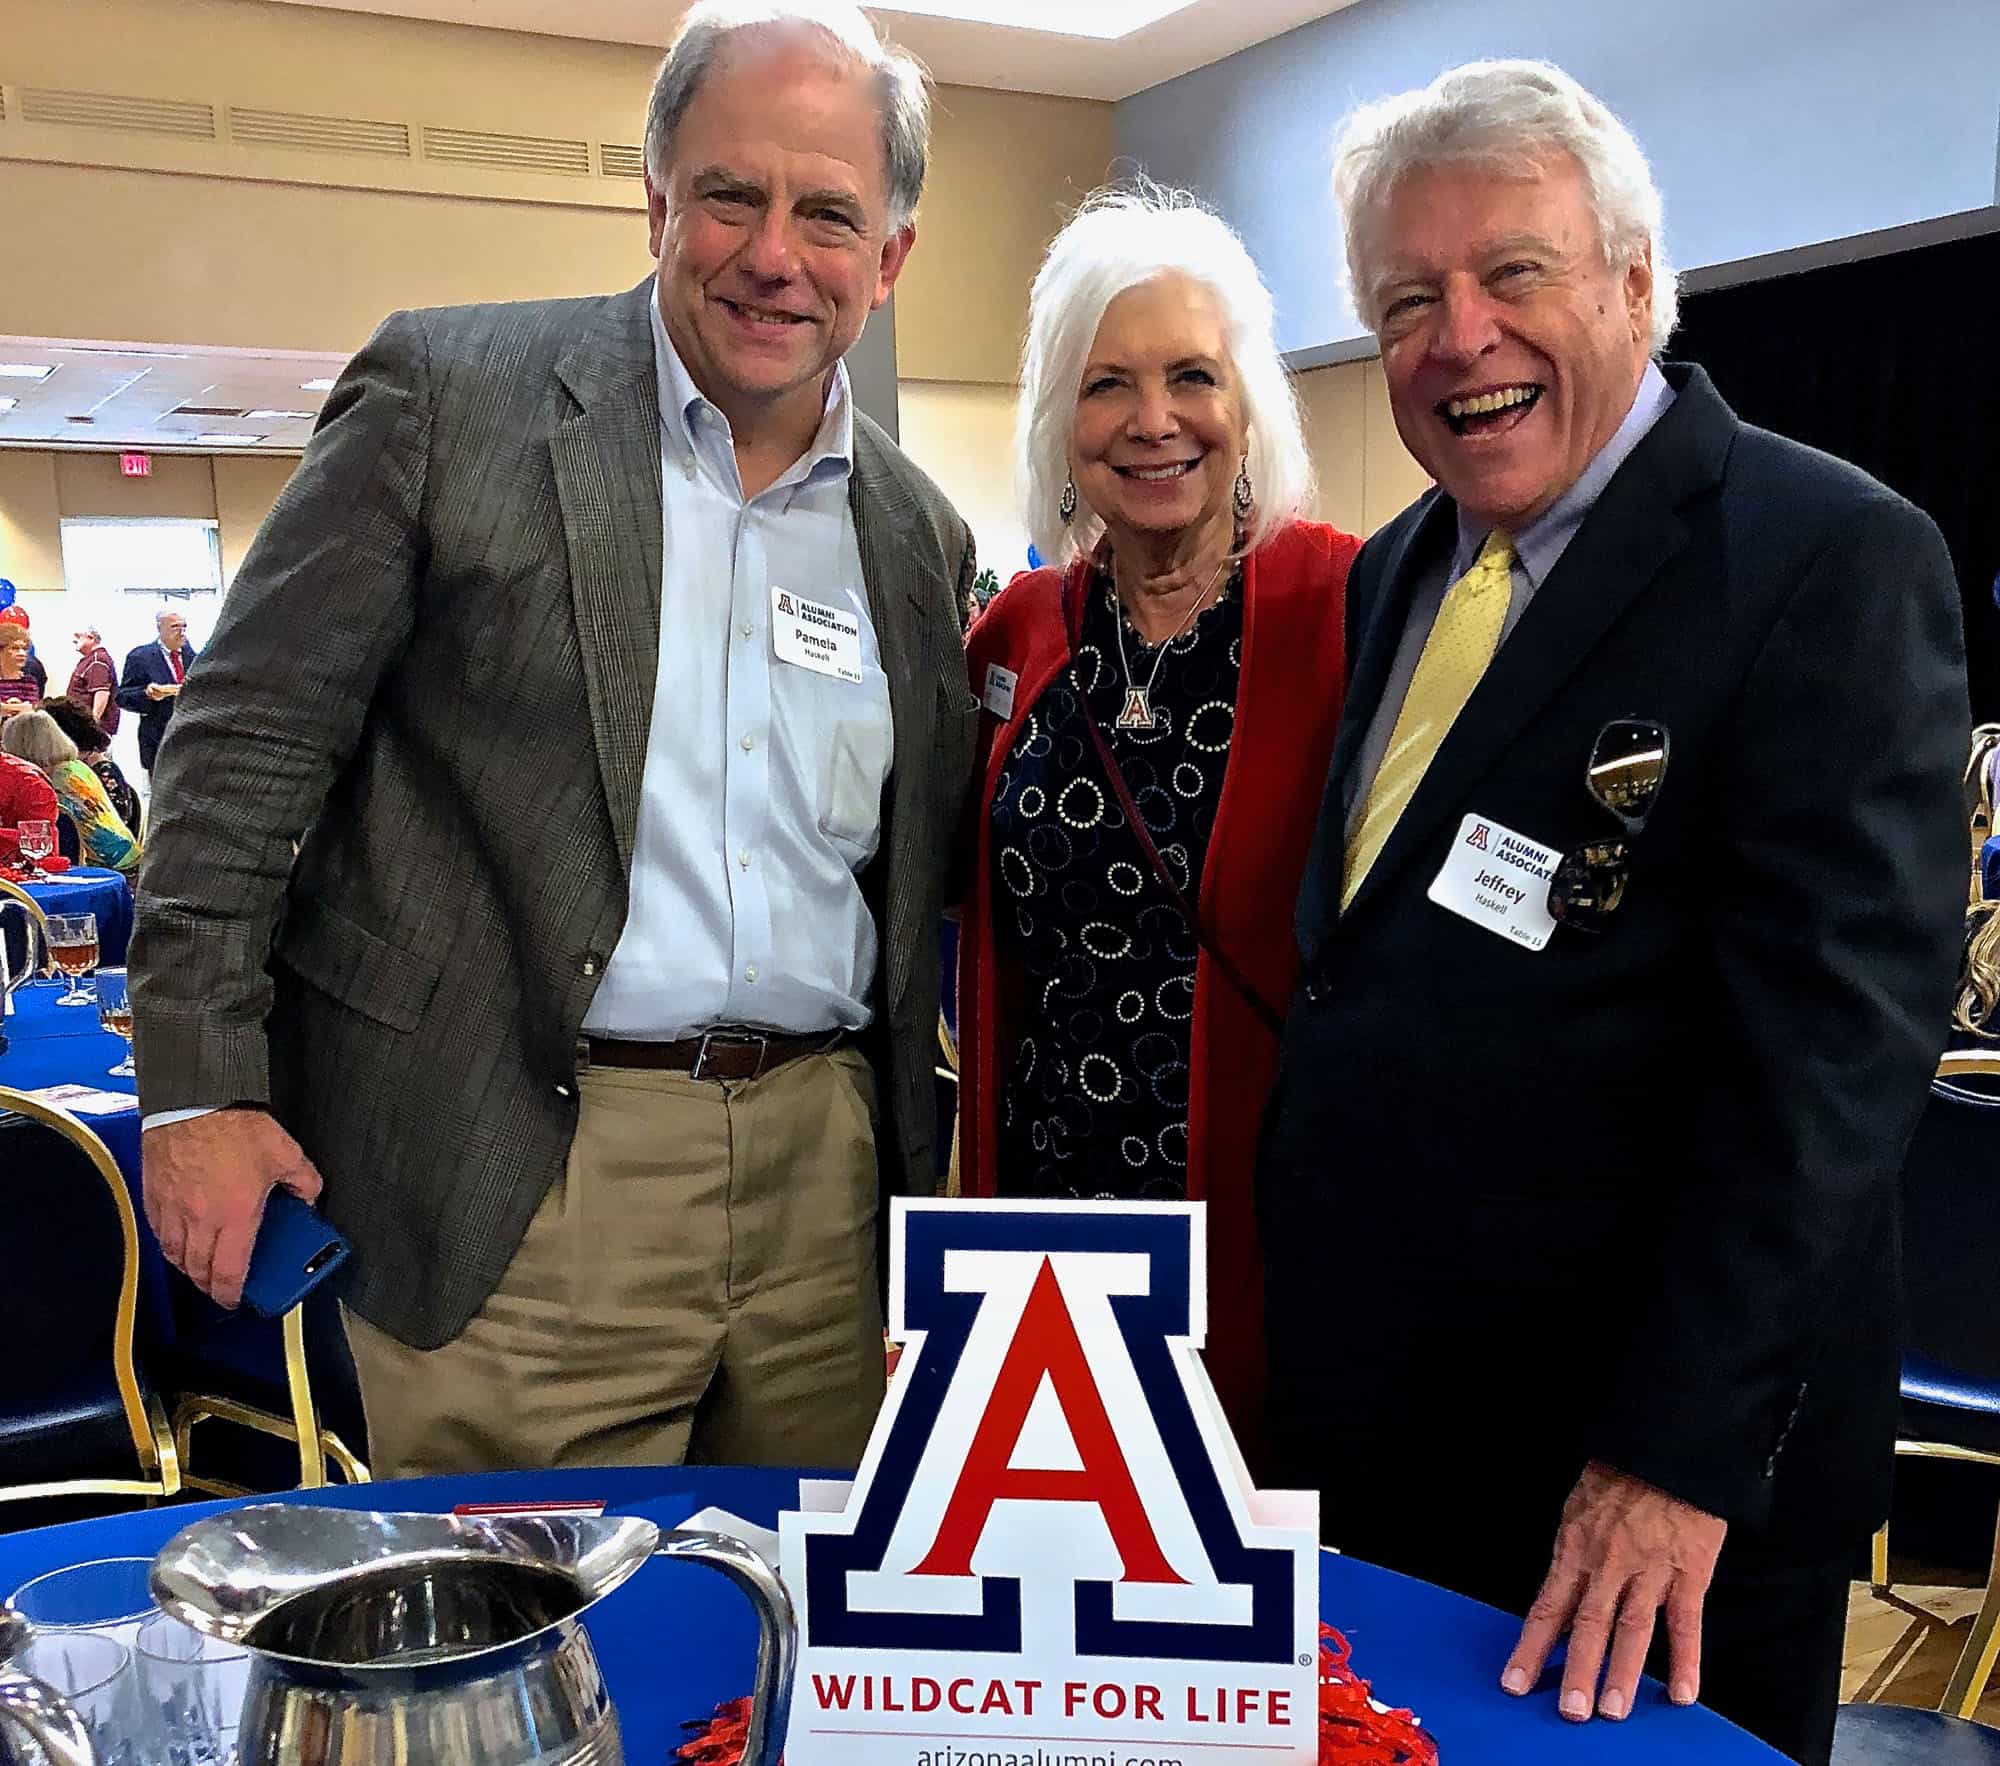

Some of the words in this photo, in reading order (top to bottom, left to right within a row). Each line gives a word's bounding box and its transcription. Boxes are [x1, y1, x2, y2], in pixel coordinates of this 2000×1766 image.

[801, 603, 835, 619] ALUMNI
[801, 612, 857, 636] ASSOCIATION
[795, 629, 837, 651] Pamela
[1466, 823, 1490, 850] A
[1502, 837, 1549, 864] ALUMNI
[1496, 849, 1553, 880] ASSOCIAT
[1474, 869, 1526, 904] Jeffrey
[1475, 893, 1508, 915] Haskell
[1509, 926, 1530, 941] Table
[805, 1210, 1295, 1664] A
[812, 1674, 1041, 1716] WILDCAT
[1064, 1682, 1164, 1720] FOR
[1187, 1687, 1292, 1726] LIFE
[918, 1745, 1183, 1766] arizonaalumni
